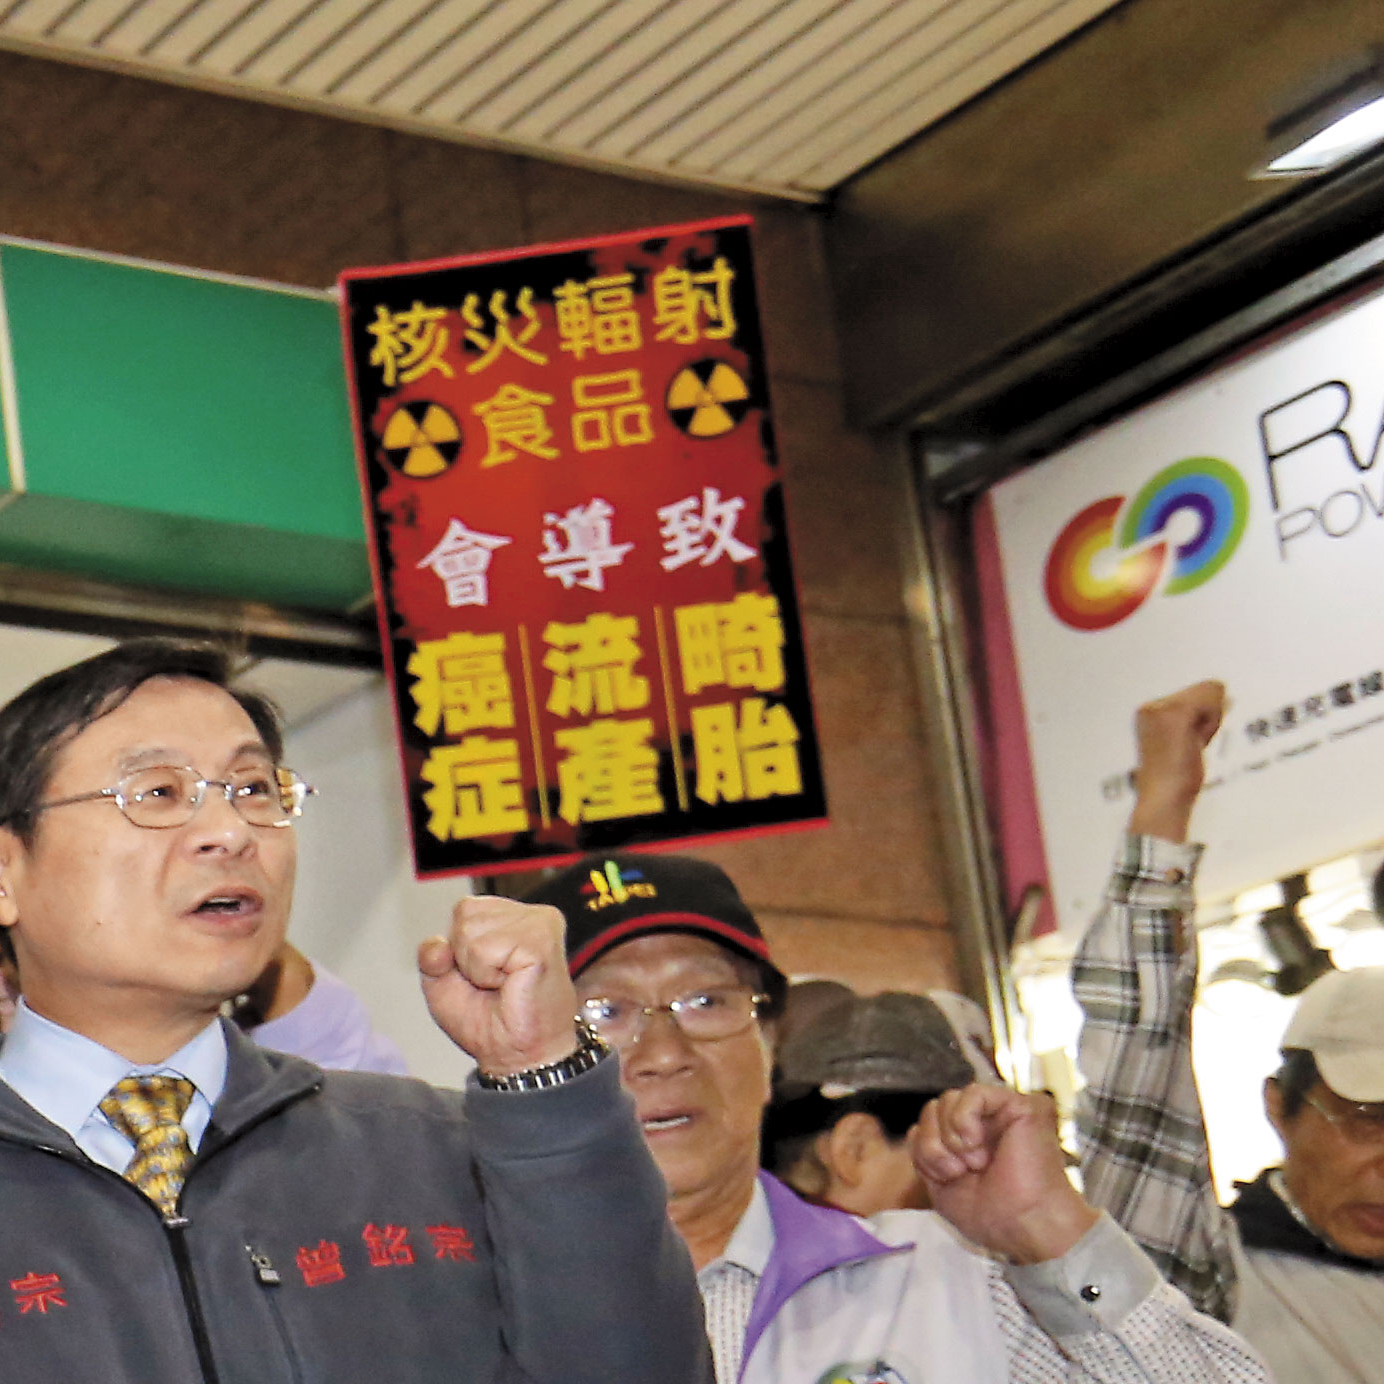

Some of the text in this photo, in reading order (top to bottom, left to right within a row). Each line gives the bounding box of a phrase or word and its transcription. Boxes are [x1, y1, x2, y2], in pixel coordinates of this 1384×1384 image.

[366, 257, 737, 387] 核災輻射
[472, 368, 654, 468] 食品
[1259, 380, 1384, 512] R
[416, 486, 759, 608] 會導致
[406, 631, 529, 842] 癌症
[542, 612, 665, 826] 流產
[673, 591, 804, 806] 畸胎
[296, 1223, 477, 1288] 曾銘宗
